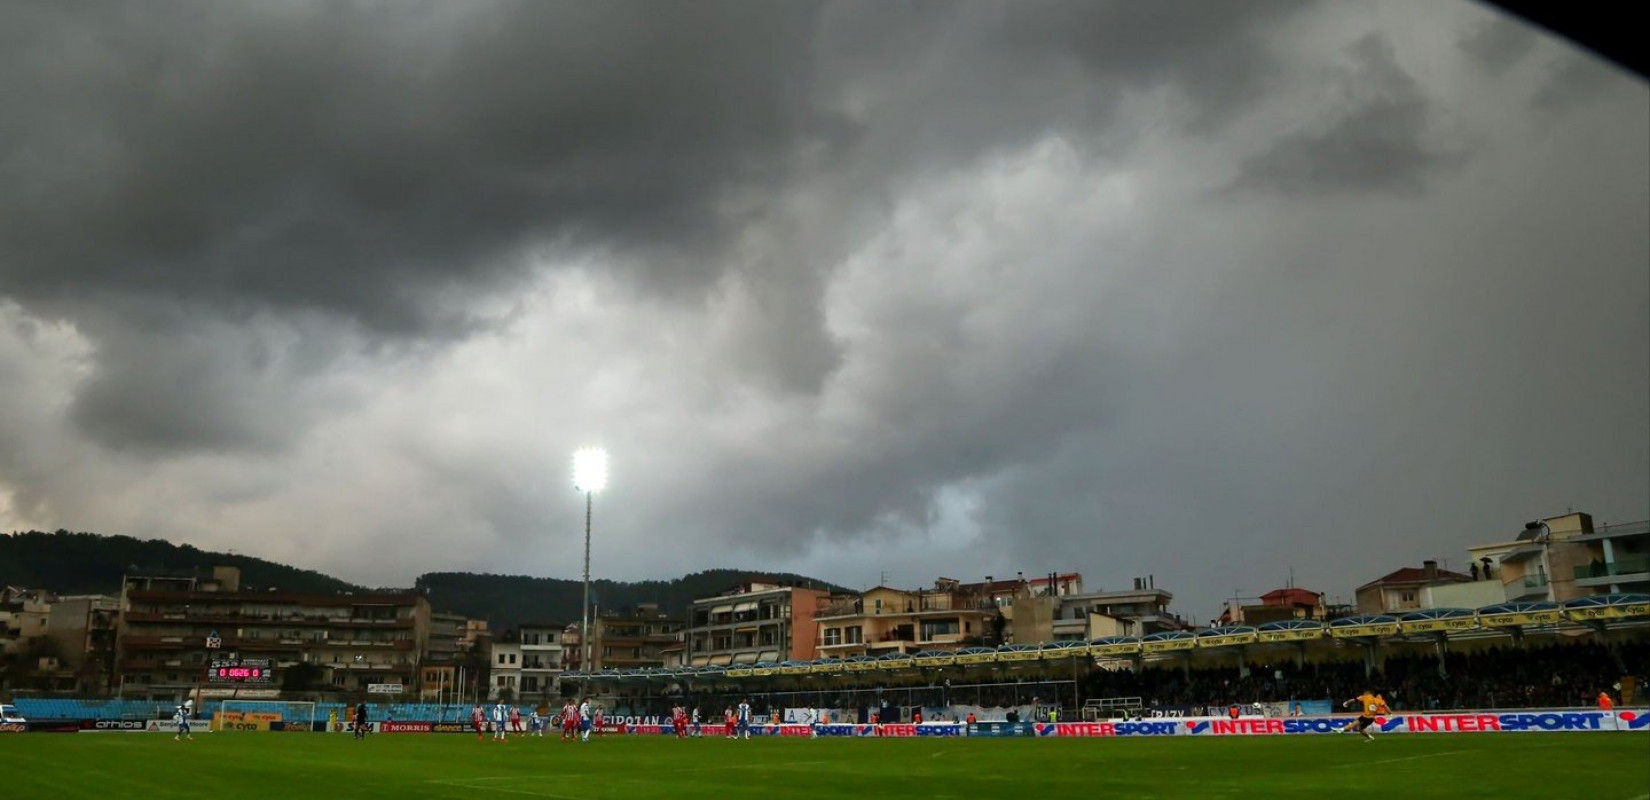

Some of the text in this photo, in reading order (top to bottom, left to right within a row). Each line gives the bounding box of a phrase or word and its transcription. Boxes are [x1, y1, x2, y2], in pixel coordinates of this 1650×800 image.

[236, 722, 258, 731] cyto
[390, 724, 430, 732] MORRIS
[1056, 721, 1178, 736] INTERSPORT
[1406, 712, 1604, 733] INTERSPORT
